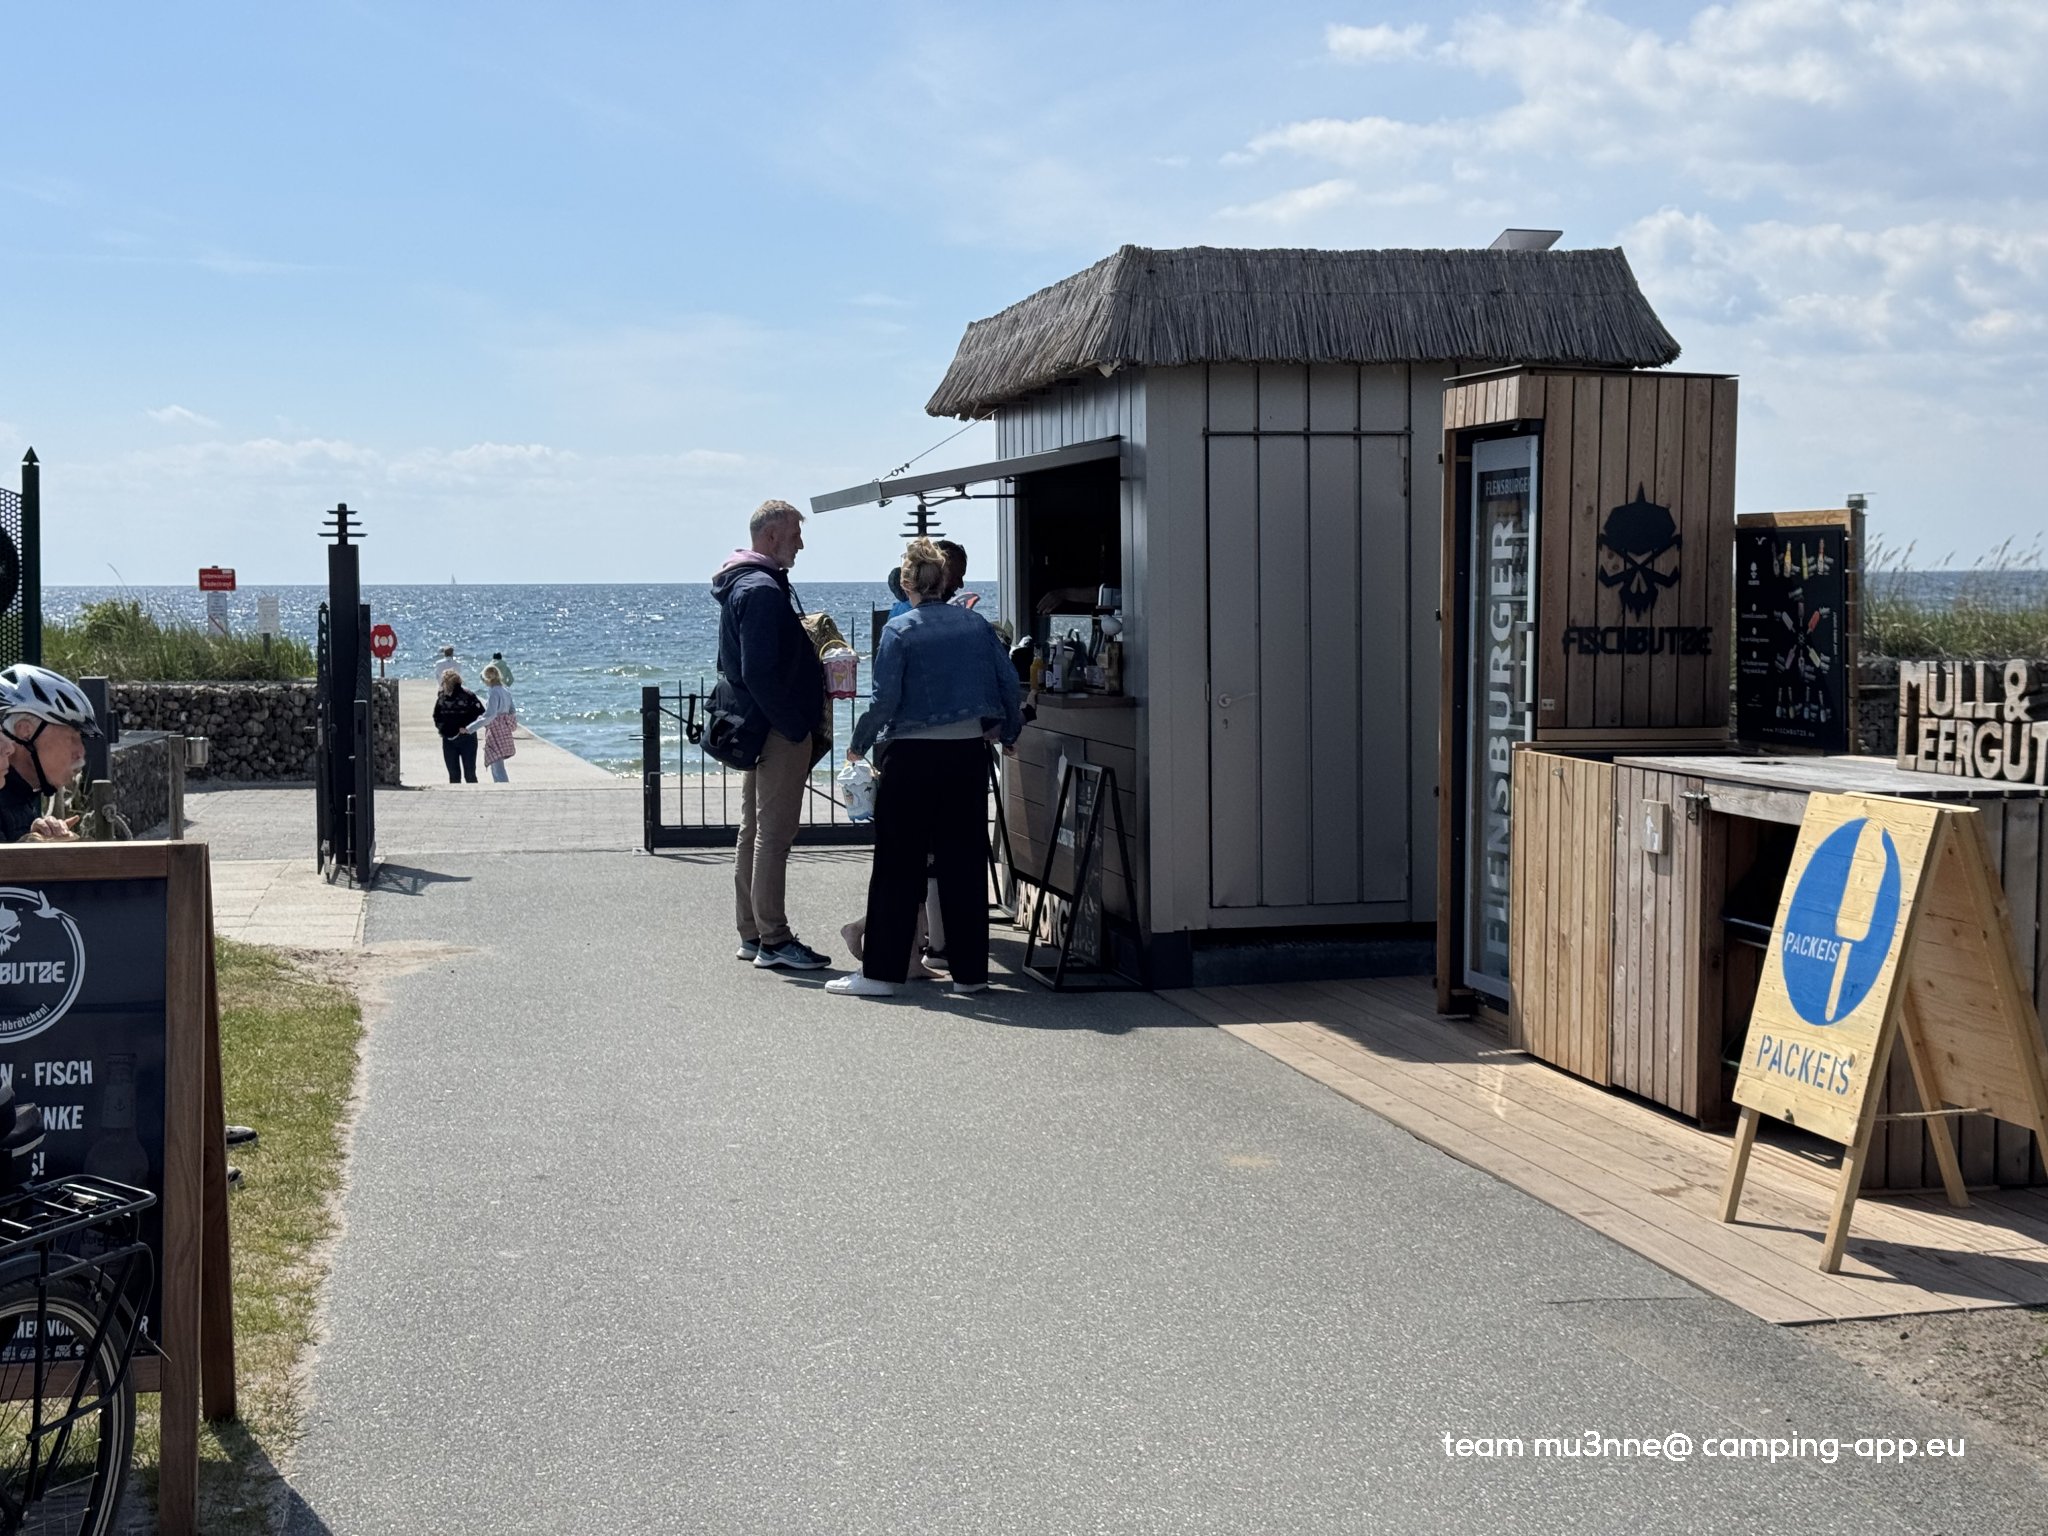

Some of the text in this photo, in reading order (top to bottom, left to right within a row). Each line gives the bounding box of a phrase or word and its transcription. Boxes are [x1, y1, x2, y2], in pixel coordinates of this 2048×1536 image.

[1485, 476, 1531, 497] FLENSBURGE
[1562, 626, 1713, 655] FISCHBUTZE
[1486, 520, 1514, 958] FLENSBURGER
[1896, 715, 2048, 786] LEERGUT
[1784, 931, 1840, 962] PACKEIS
[34, 1060, 93, 1086] FISCH
[1756, 1034, 1853, 1095] PACKEIS
[38, 1105, 84, 1130] NKE
